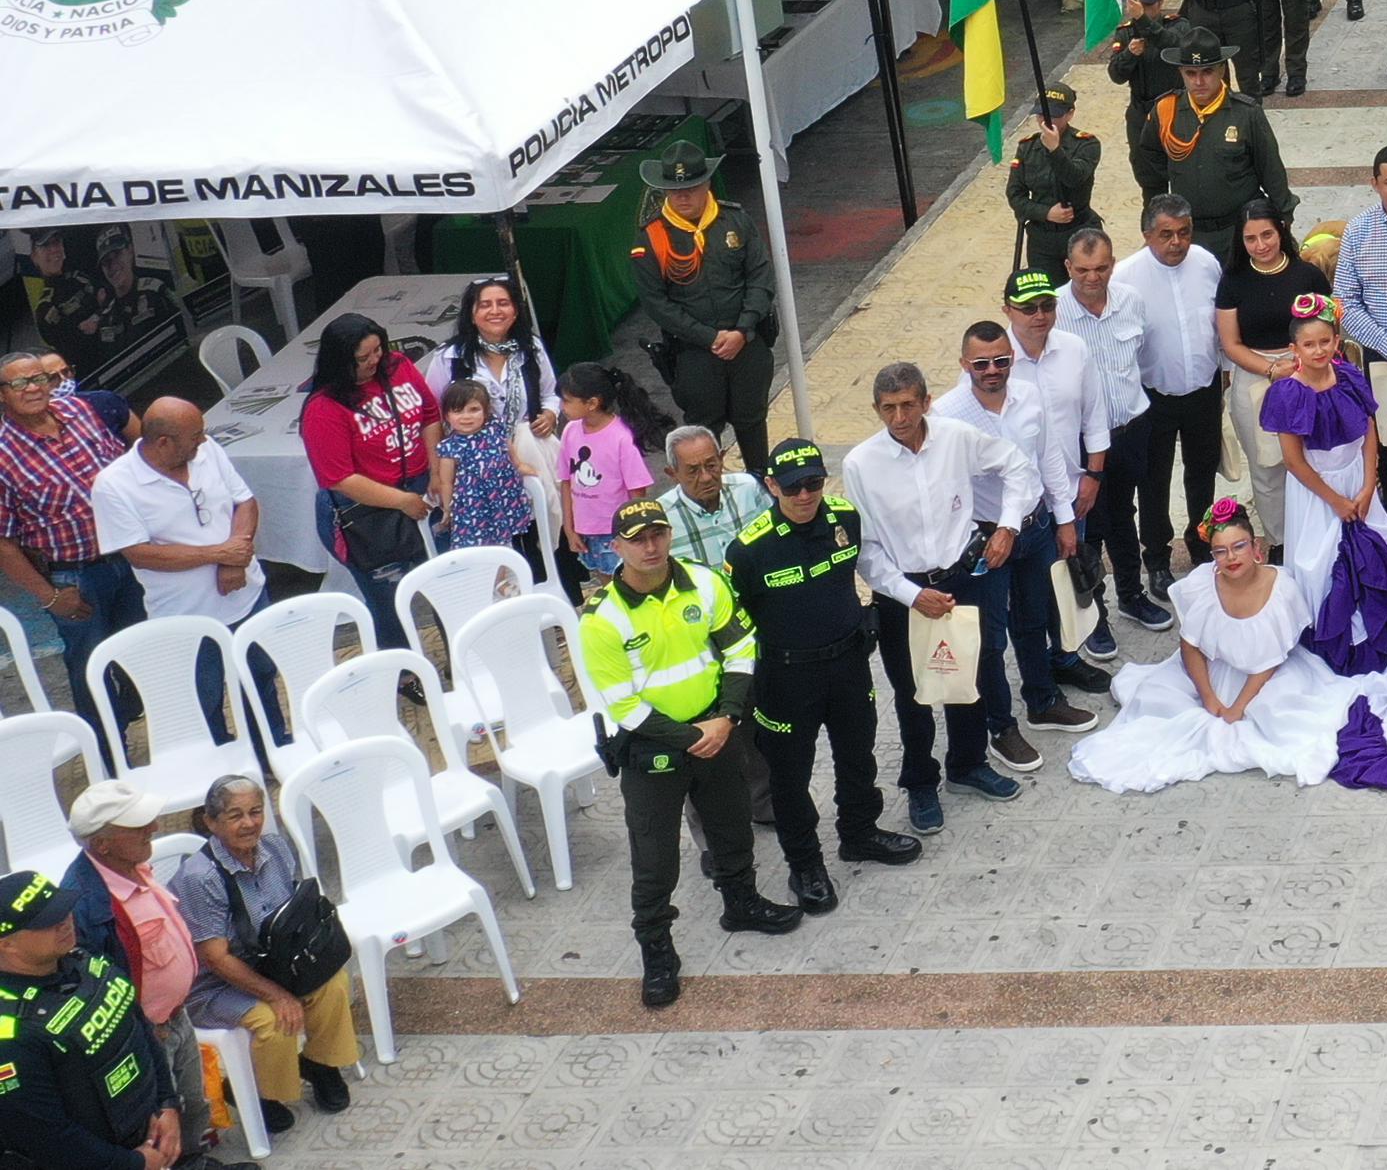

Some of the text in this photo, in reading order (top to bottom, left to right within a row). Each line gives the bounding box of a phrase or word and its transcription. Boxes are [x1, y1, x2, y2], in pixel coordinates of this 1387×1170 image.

[1, 14, 135, 40] DIOS Y PATRIA
[122, 178, 190, 207] DE
[194, 171, 477, 202] MANIZALES
[1016, 273, 1049, 286] CALDAS
[775, 445, 819, 466] POLICÍA
[81, 976, 130, 1042] POLICÍA
